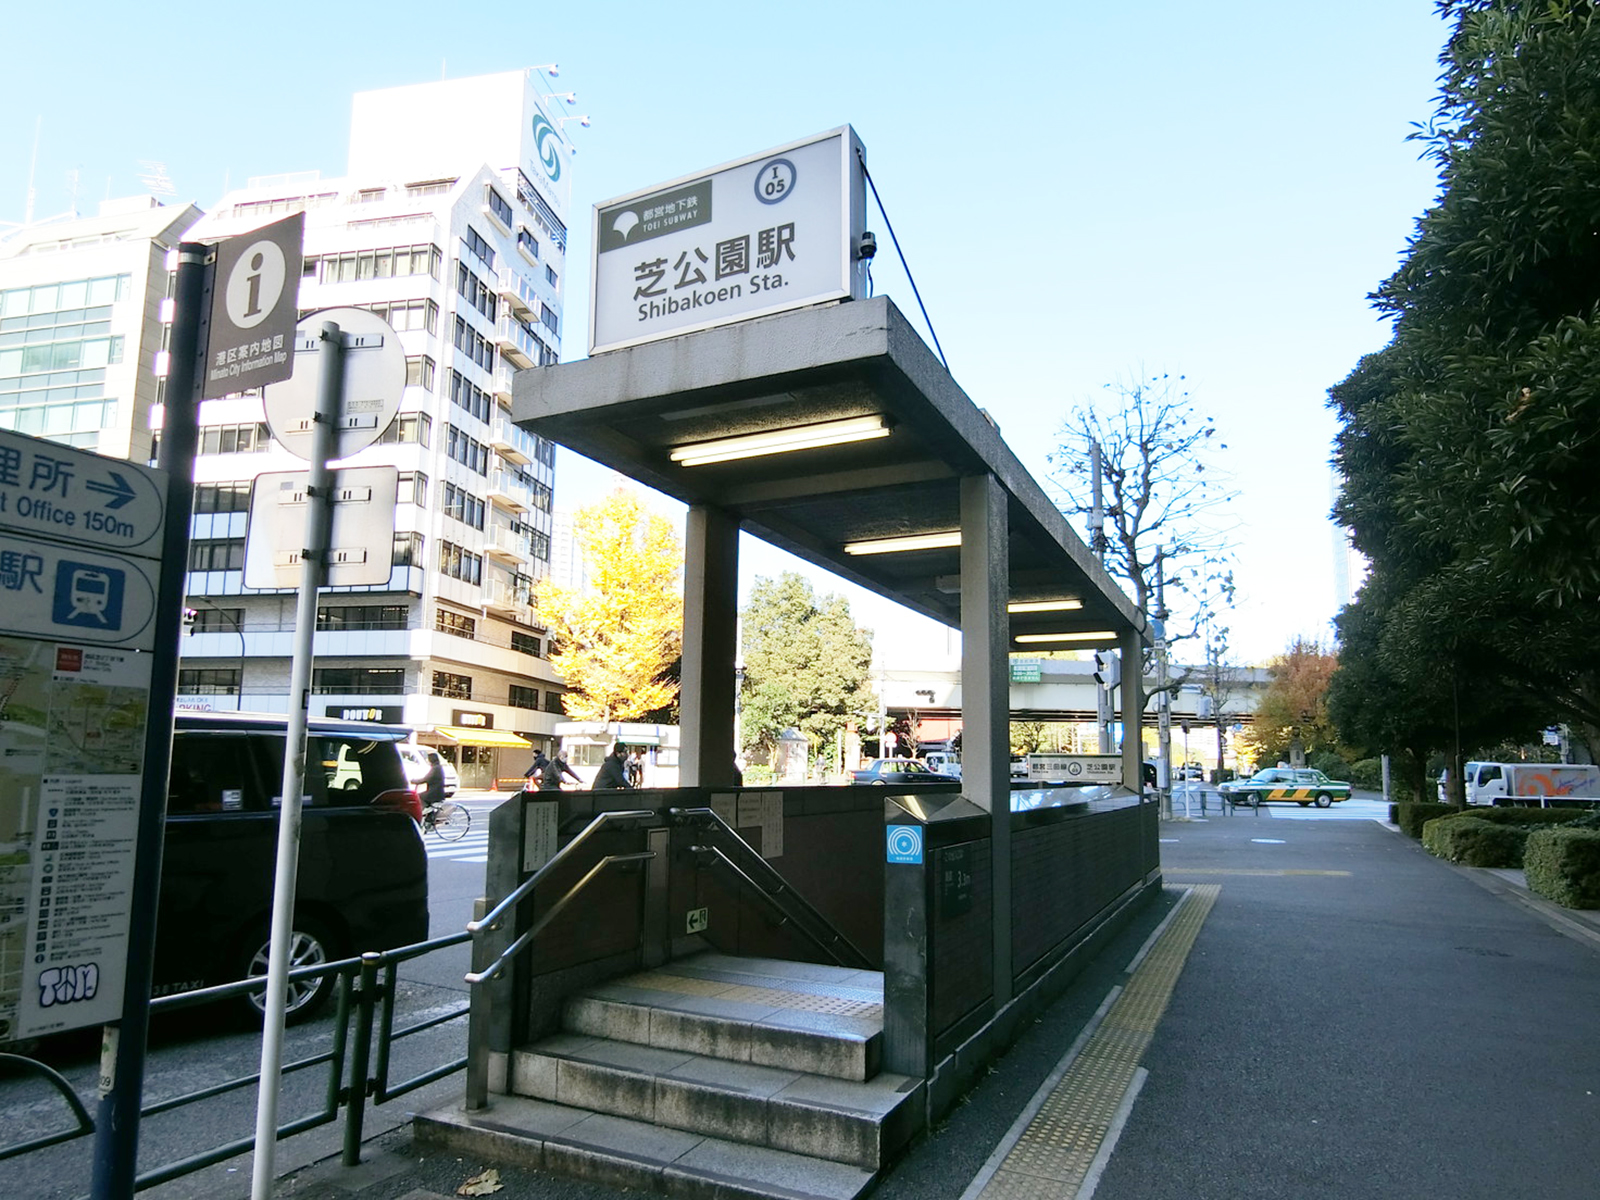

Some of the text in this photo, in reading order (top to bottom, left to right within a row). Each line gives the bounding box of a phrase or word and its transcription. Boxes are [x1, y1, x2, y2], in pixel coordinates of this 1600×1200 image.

[765, 180, 785, 196] 05
[772, 167, 779, 179] I
[643, 197, 698, 221] 都営地下鉄
[643, 210, 698, 232] TOEI SUBWAY
[633, 222, 796, 302] 芝公園駅
[638, 272, 789, 322] Shibakoen Sta.
[215, 334, 284, 366] 港区案内地図
[210, 351, 287, 381] Minato City Information Map
[17, 496, 76, 526] Office
[83, 511, 134, 538] 150m
[0, 550, 43, 594] 駅
[343, 708, 383, 721] DOUTOR
